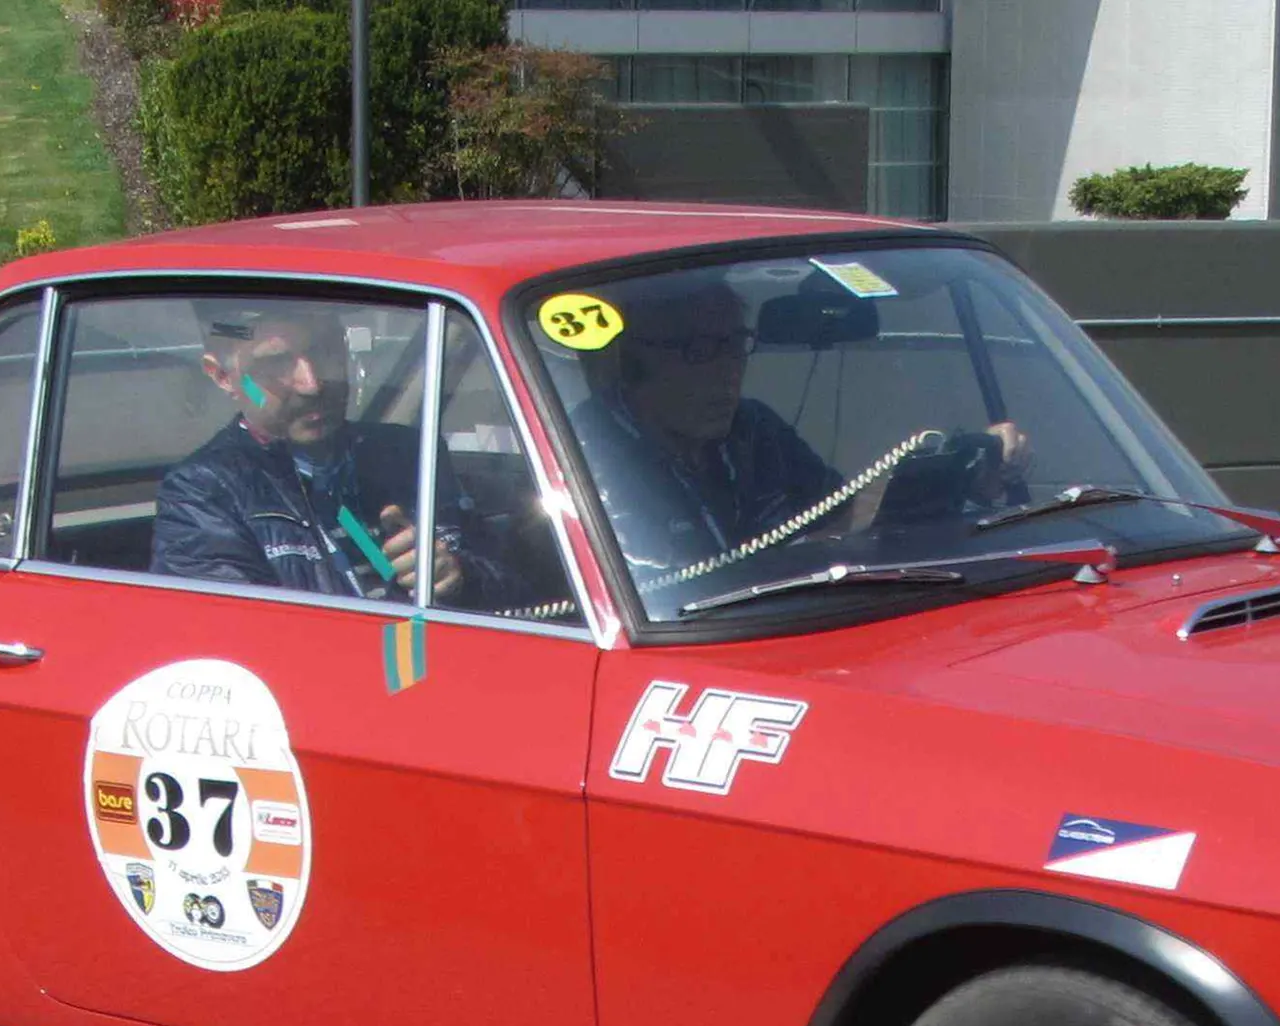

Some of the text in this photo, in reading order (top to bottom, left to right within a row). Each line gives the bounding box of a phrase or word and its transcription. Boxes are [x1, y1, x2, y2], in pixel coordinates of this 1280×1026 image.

[550, 304, 609, 337] 37
[166, 681, 232, 705] COPPA
[120, 700, 260, 764] ROTARI
[609, 680, 808, 795] HF
[145, 772, 239, 857] 37
